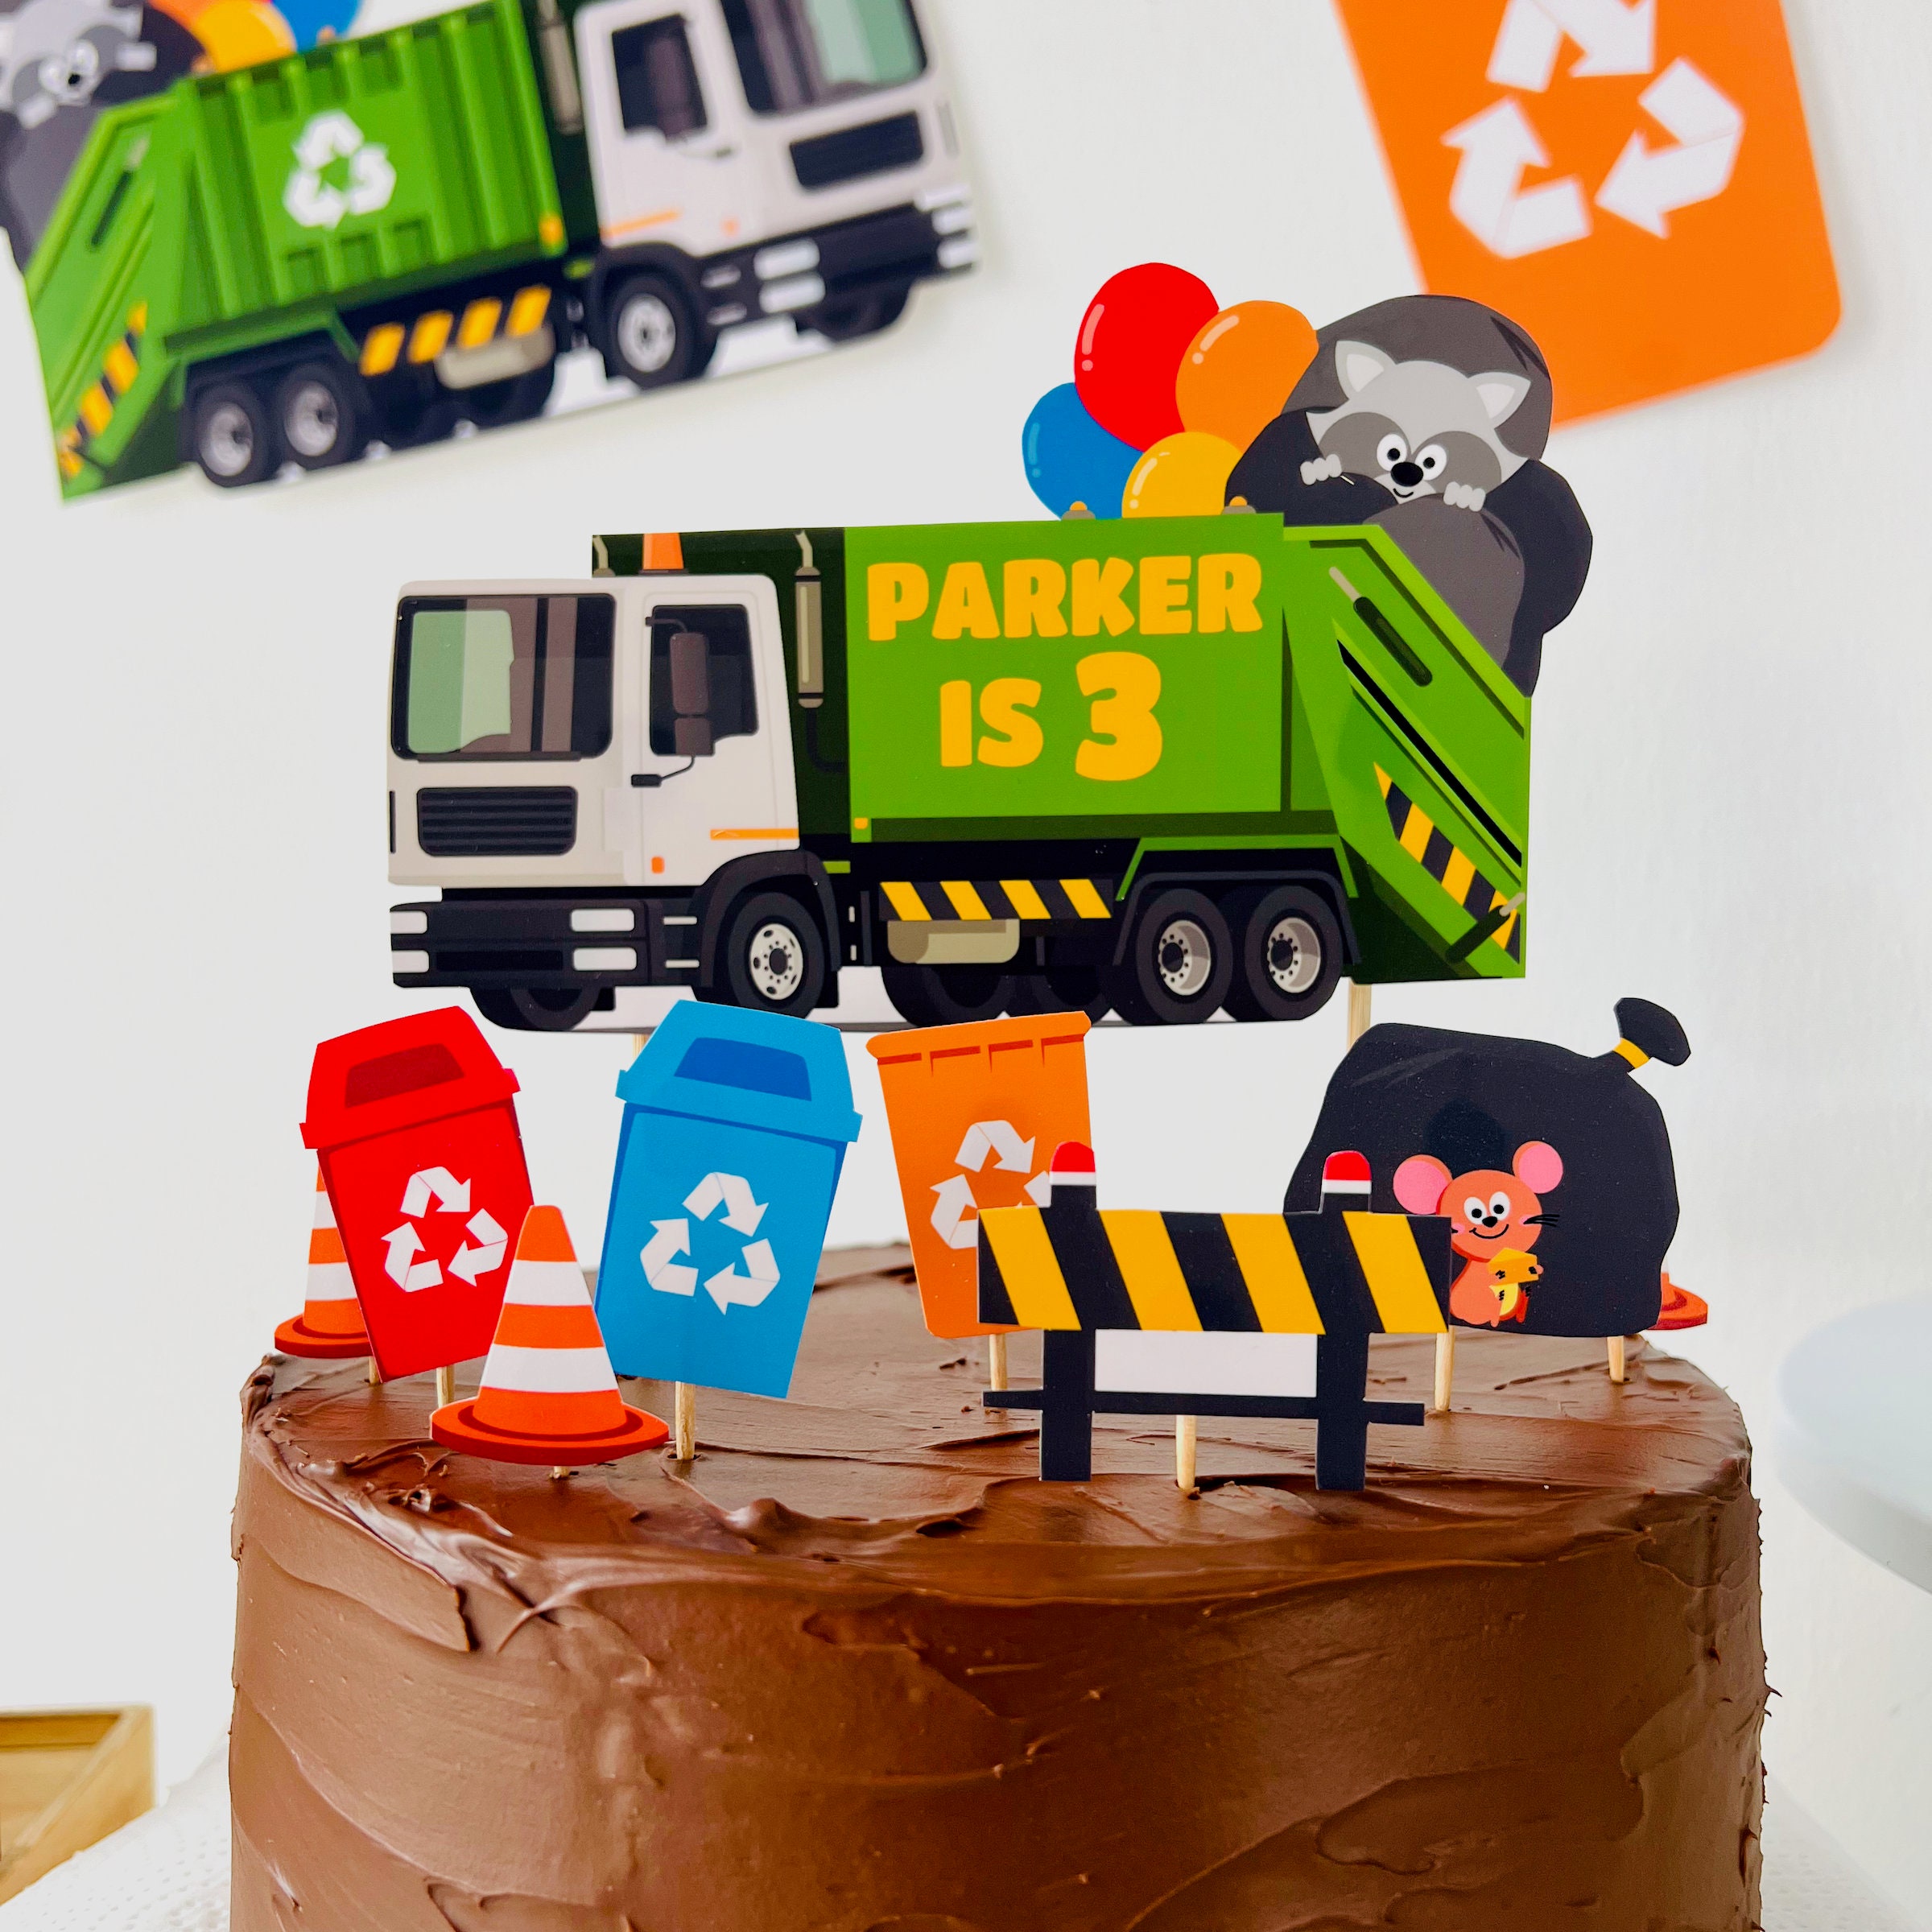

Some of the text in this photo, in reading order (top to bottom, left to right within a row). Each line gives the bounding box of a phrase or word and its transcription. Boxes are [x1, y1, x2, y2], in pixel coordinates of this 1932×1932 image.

[867, 552, 1264, 642] PARKER
[939, 651, 1164, 782] IS 3
